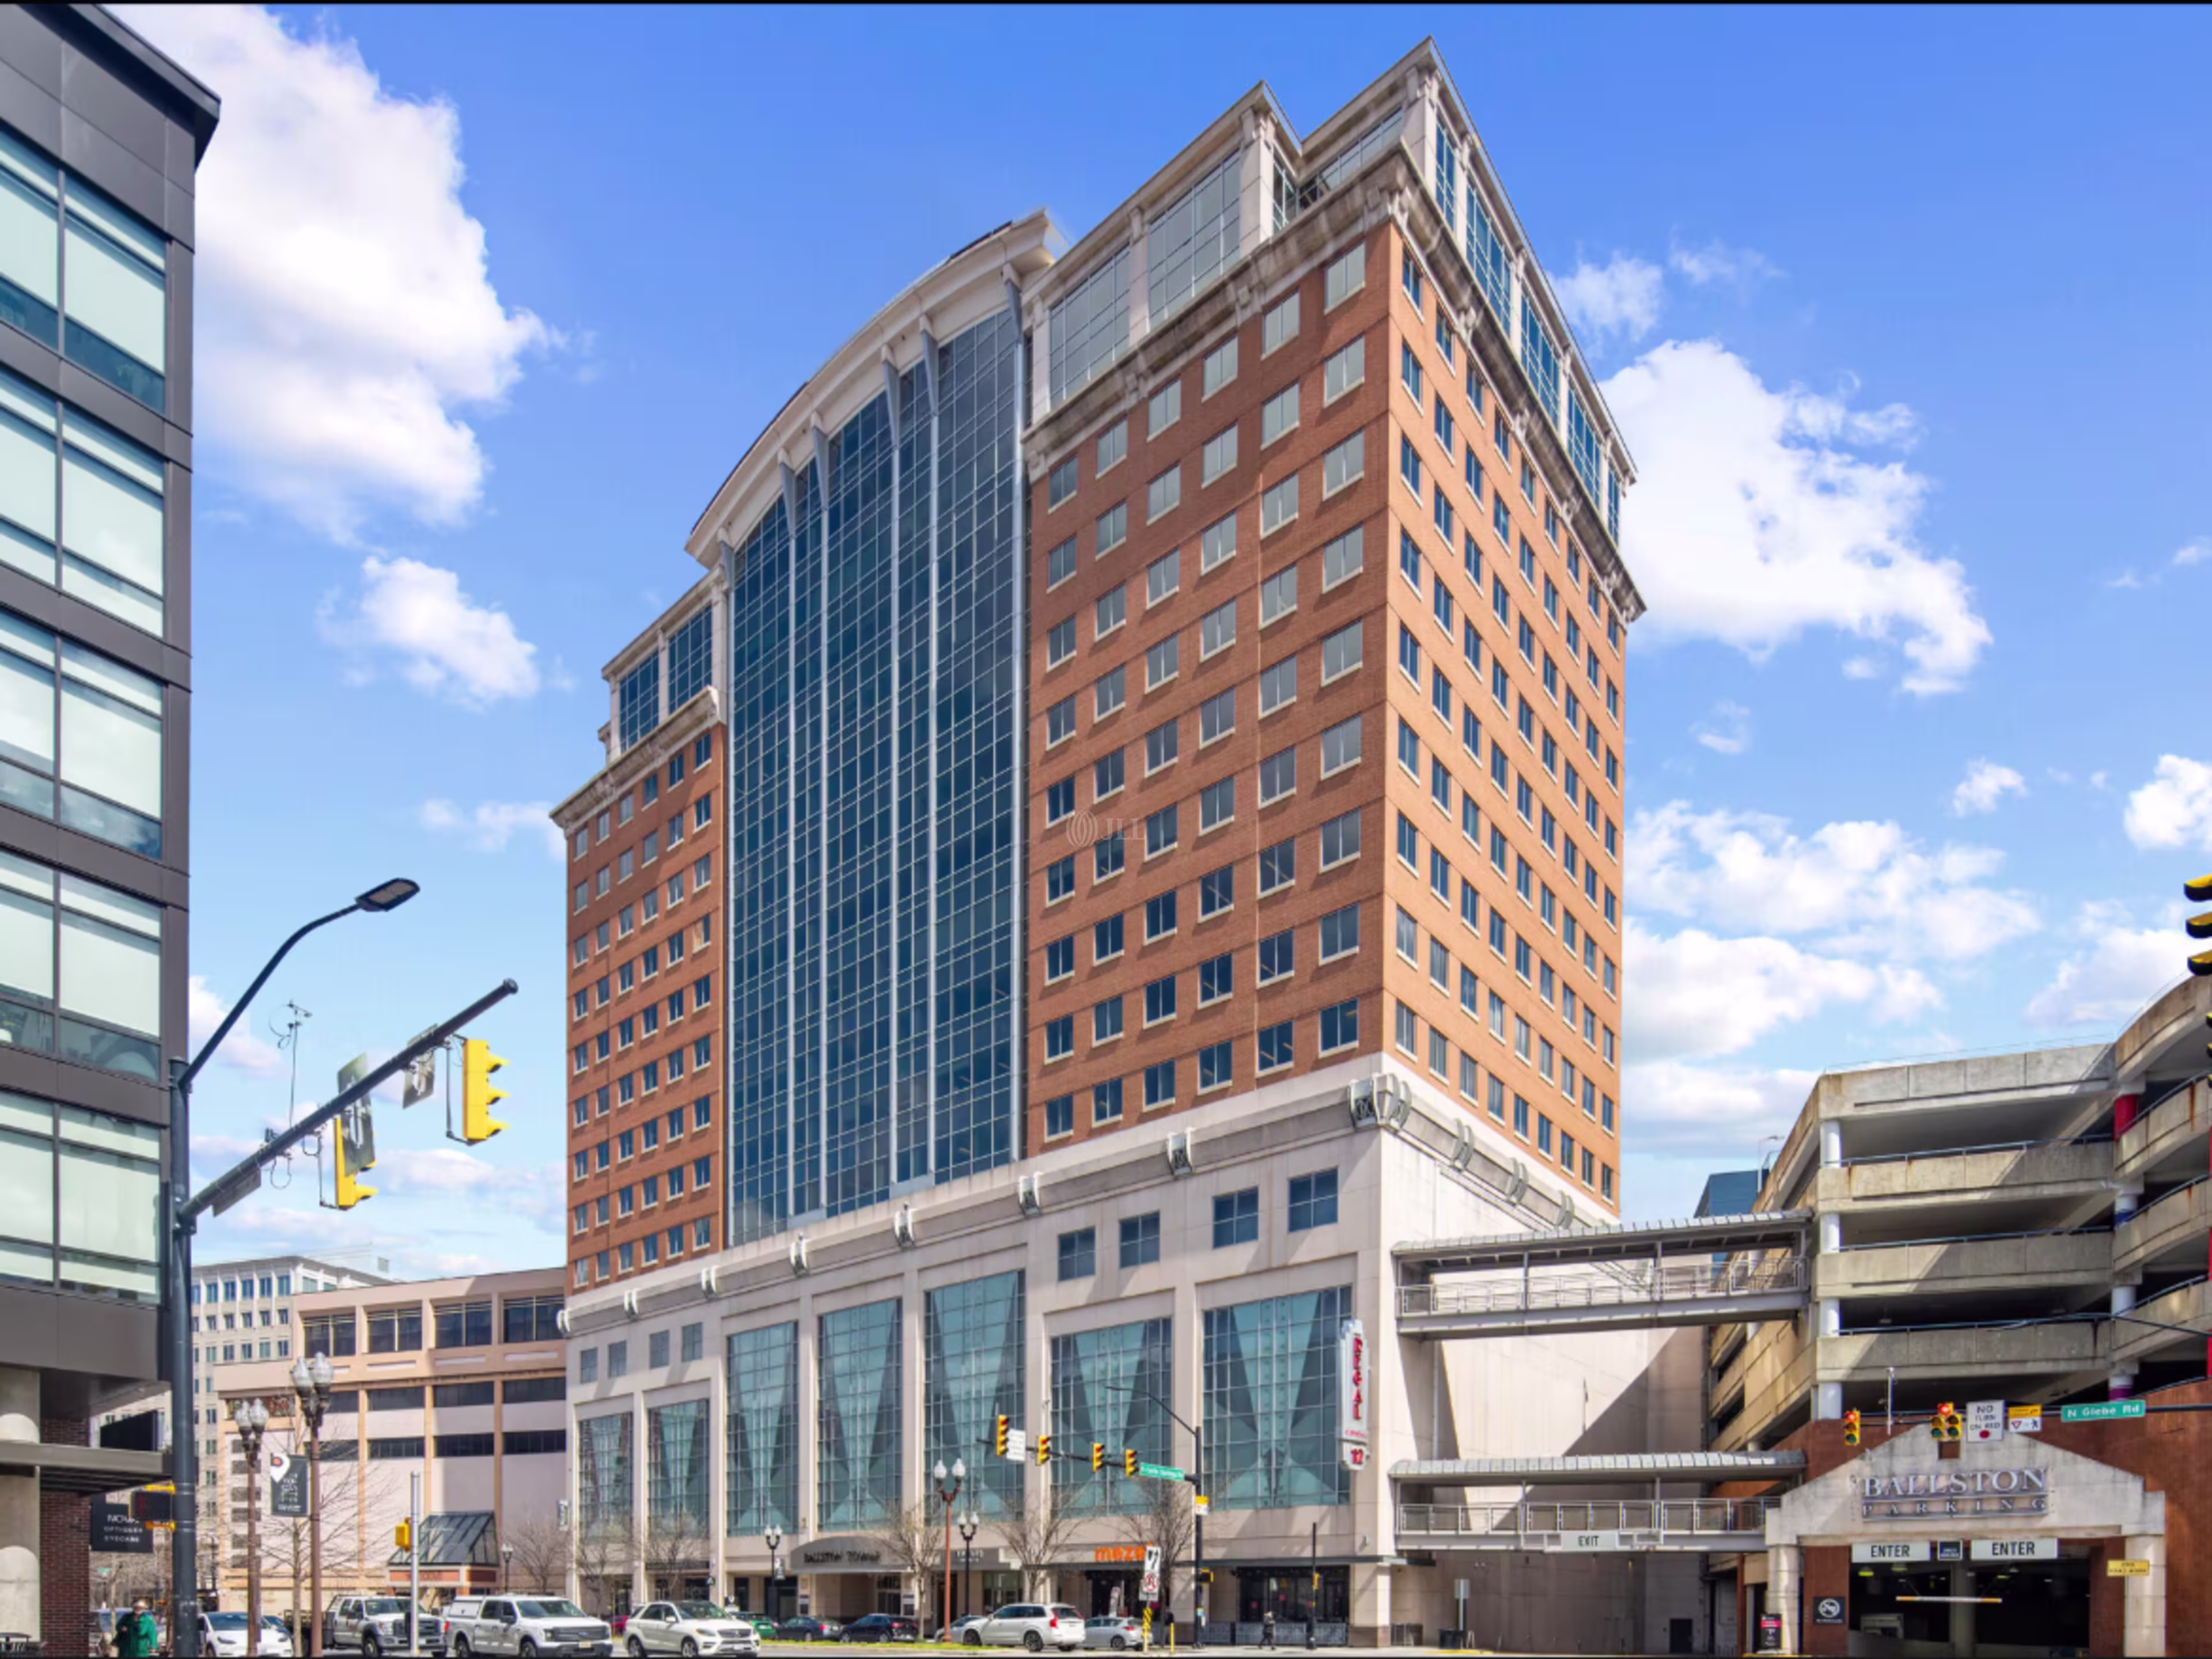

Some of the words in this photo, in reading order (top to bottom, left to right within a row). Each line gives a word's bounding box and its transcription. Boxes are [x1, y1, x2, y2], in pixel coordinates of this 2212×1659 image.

[1353, 1335, 1363, 1420] REGAL
[1976, 1405, 1993, 1413] NO
[2067, 1408, 2077, 1418] N
[2081, 1407, 2116, 1416] Glebe
[2123, 1404, 2139, 1413] Rd
[1351, 1448, 1363, 1465] 12
[1864, 1469, 2046, 1497] BALLSTON
[1862, 1498, 2046, 1517] PARKING
[1578, 1536, 1599, 1547] EXIT
[1992, 1541, 2035, 1555] ENTER
[1872, 1545, 1910, 1558] ENTER
